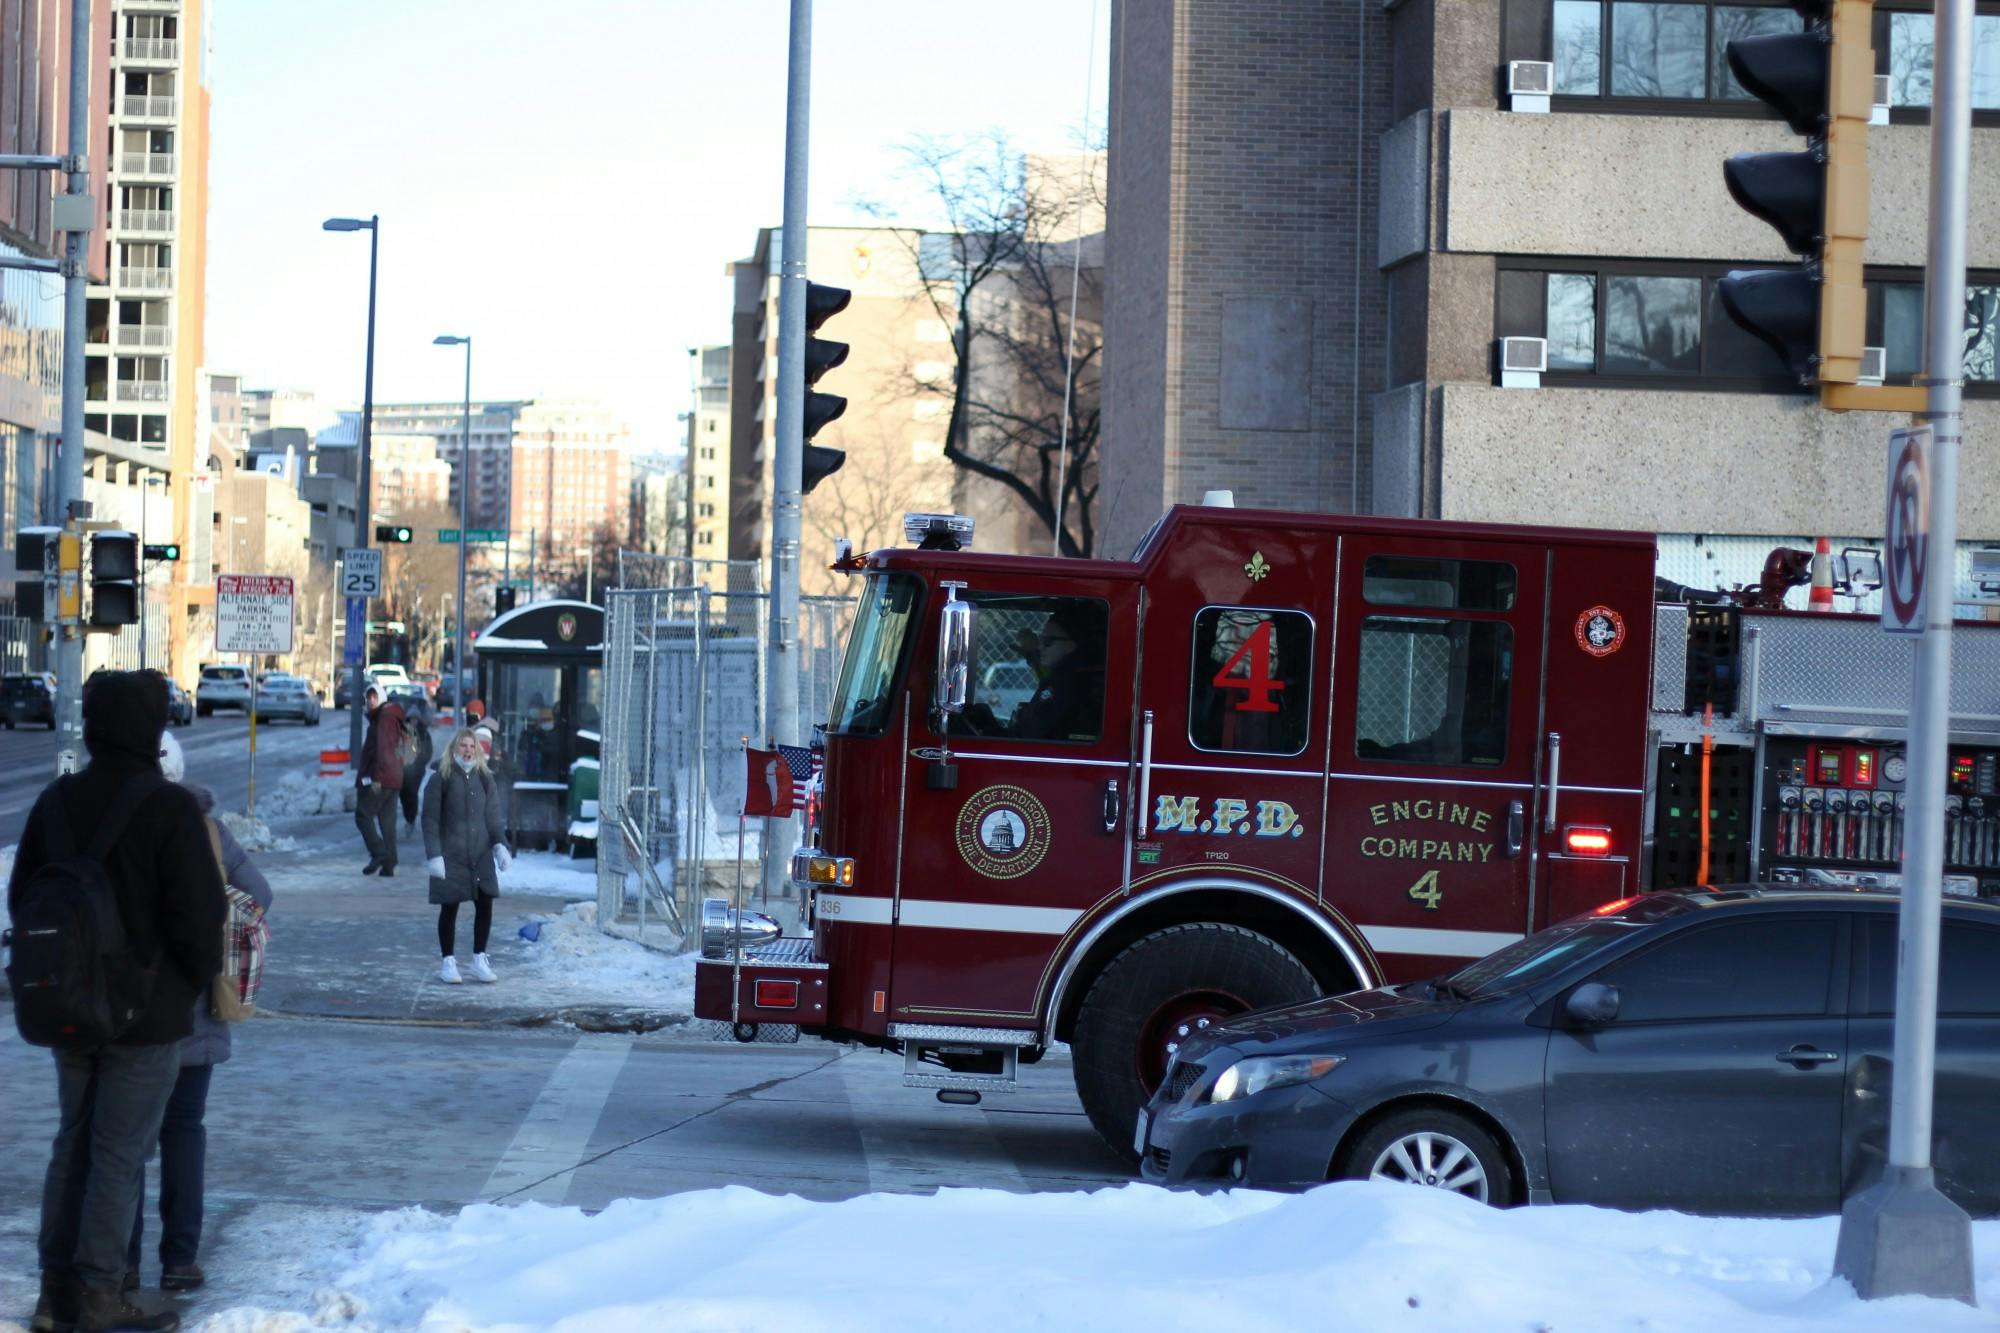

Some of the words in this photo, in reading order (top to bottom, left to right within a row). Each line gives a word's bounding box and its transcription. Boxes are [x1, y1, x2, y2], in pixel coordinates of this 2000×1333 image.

[346, 551, 378, 559] SPEED
[350, 562, 374, 570] LIMIT
[346, 574, 376, 592] 25
[221, 594, 265, 604] ALTERNATE
[271, 595, 288, 605] SIDE
[237, 605, 273, 615] PARKING
[220, 614, 258, 622] REGULATIONS
[269, 615, 288, 623] EFFECT
[562, 623, 572, 635] W
[1213, 620, 1285, 712] 4
[963, 799, 982, 823] CITY
[982, 790, 998, 803] OF
[1001, 790, 1045, 828] MADISON
[1154, 795, 1304, 838] M.F.D.
[1369, 800, 1492, 833] ENGINE
[961, 834, 979, 860] FIRE
[977, 838, 1044, 874] DEPARTMENT
[1204, 851, 1229, 860] TP120
[1360, 837, 1494, 863] COMPANY
[1409, 870, 1443, 909] 4
[820, 900, 840, 913] 836
